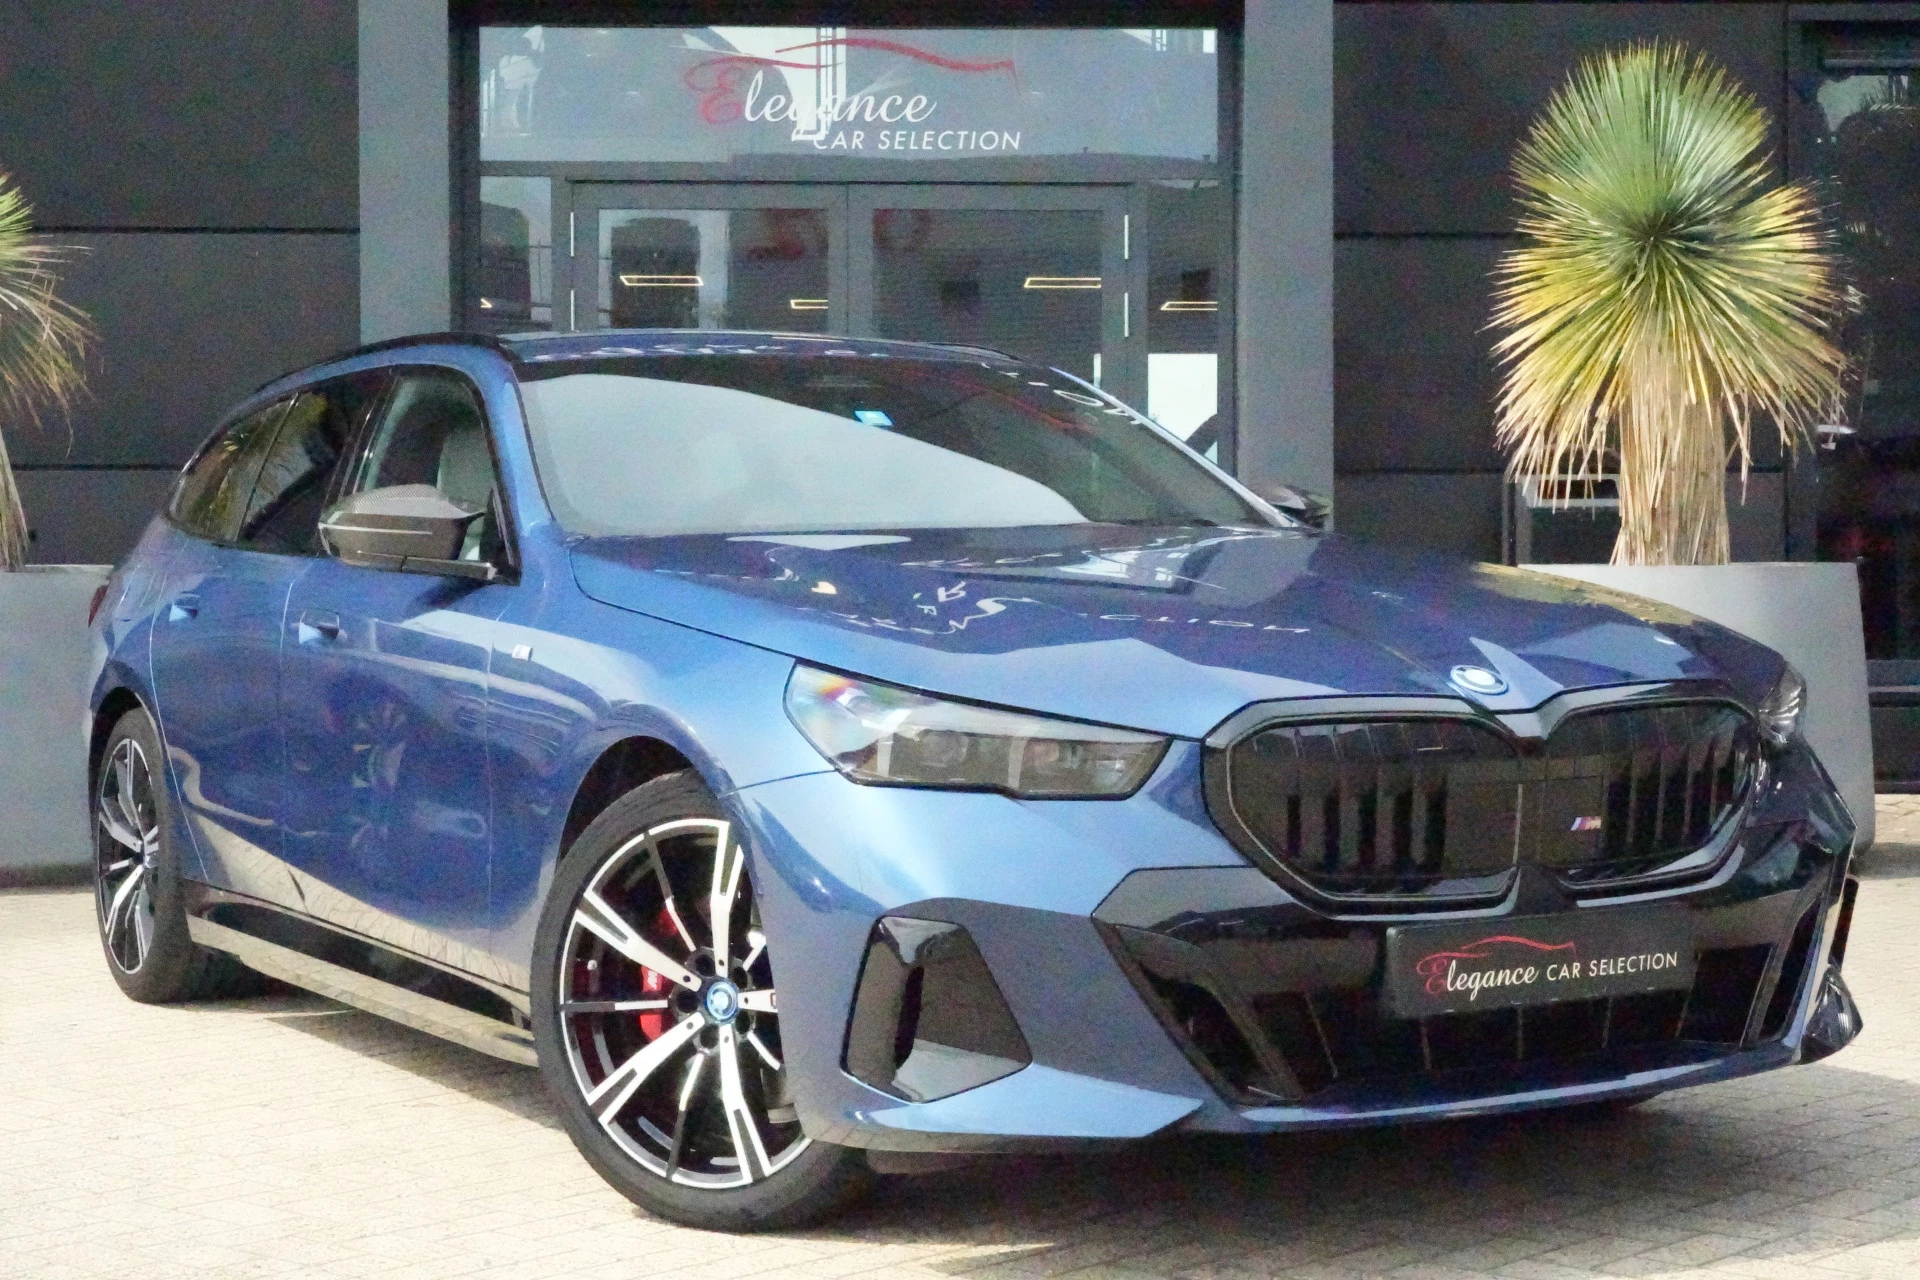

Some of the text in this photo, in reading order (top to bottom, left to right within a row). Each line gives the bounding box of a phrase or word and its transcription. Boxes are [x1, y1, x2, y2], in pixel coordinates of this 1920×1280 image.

[813, 129, 1022, 151] CAR SELECTION
[1416, 951, 1679, 1001] Elegance CAR SELECTION
